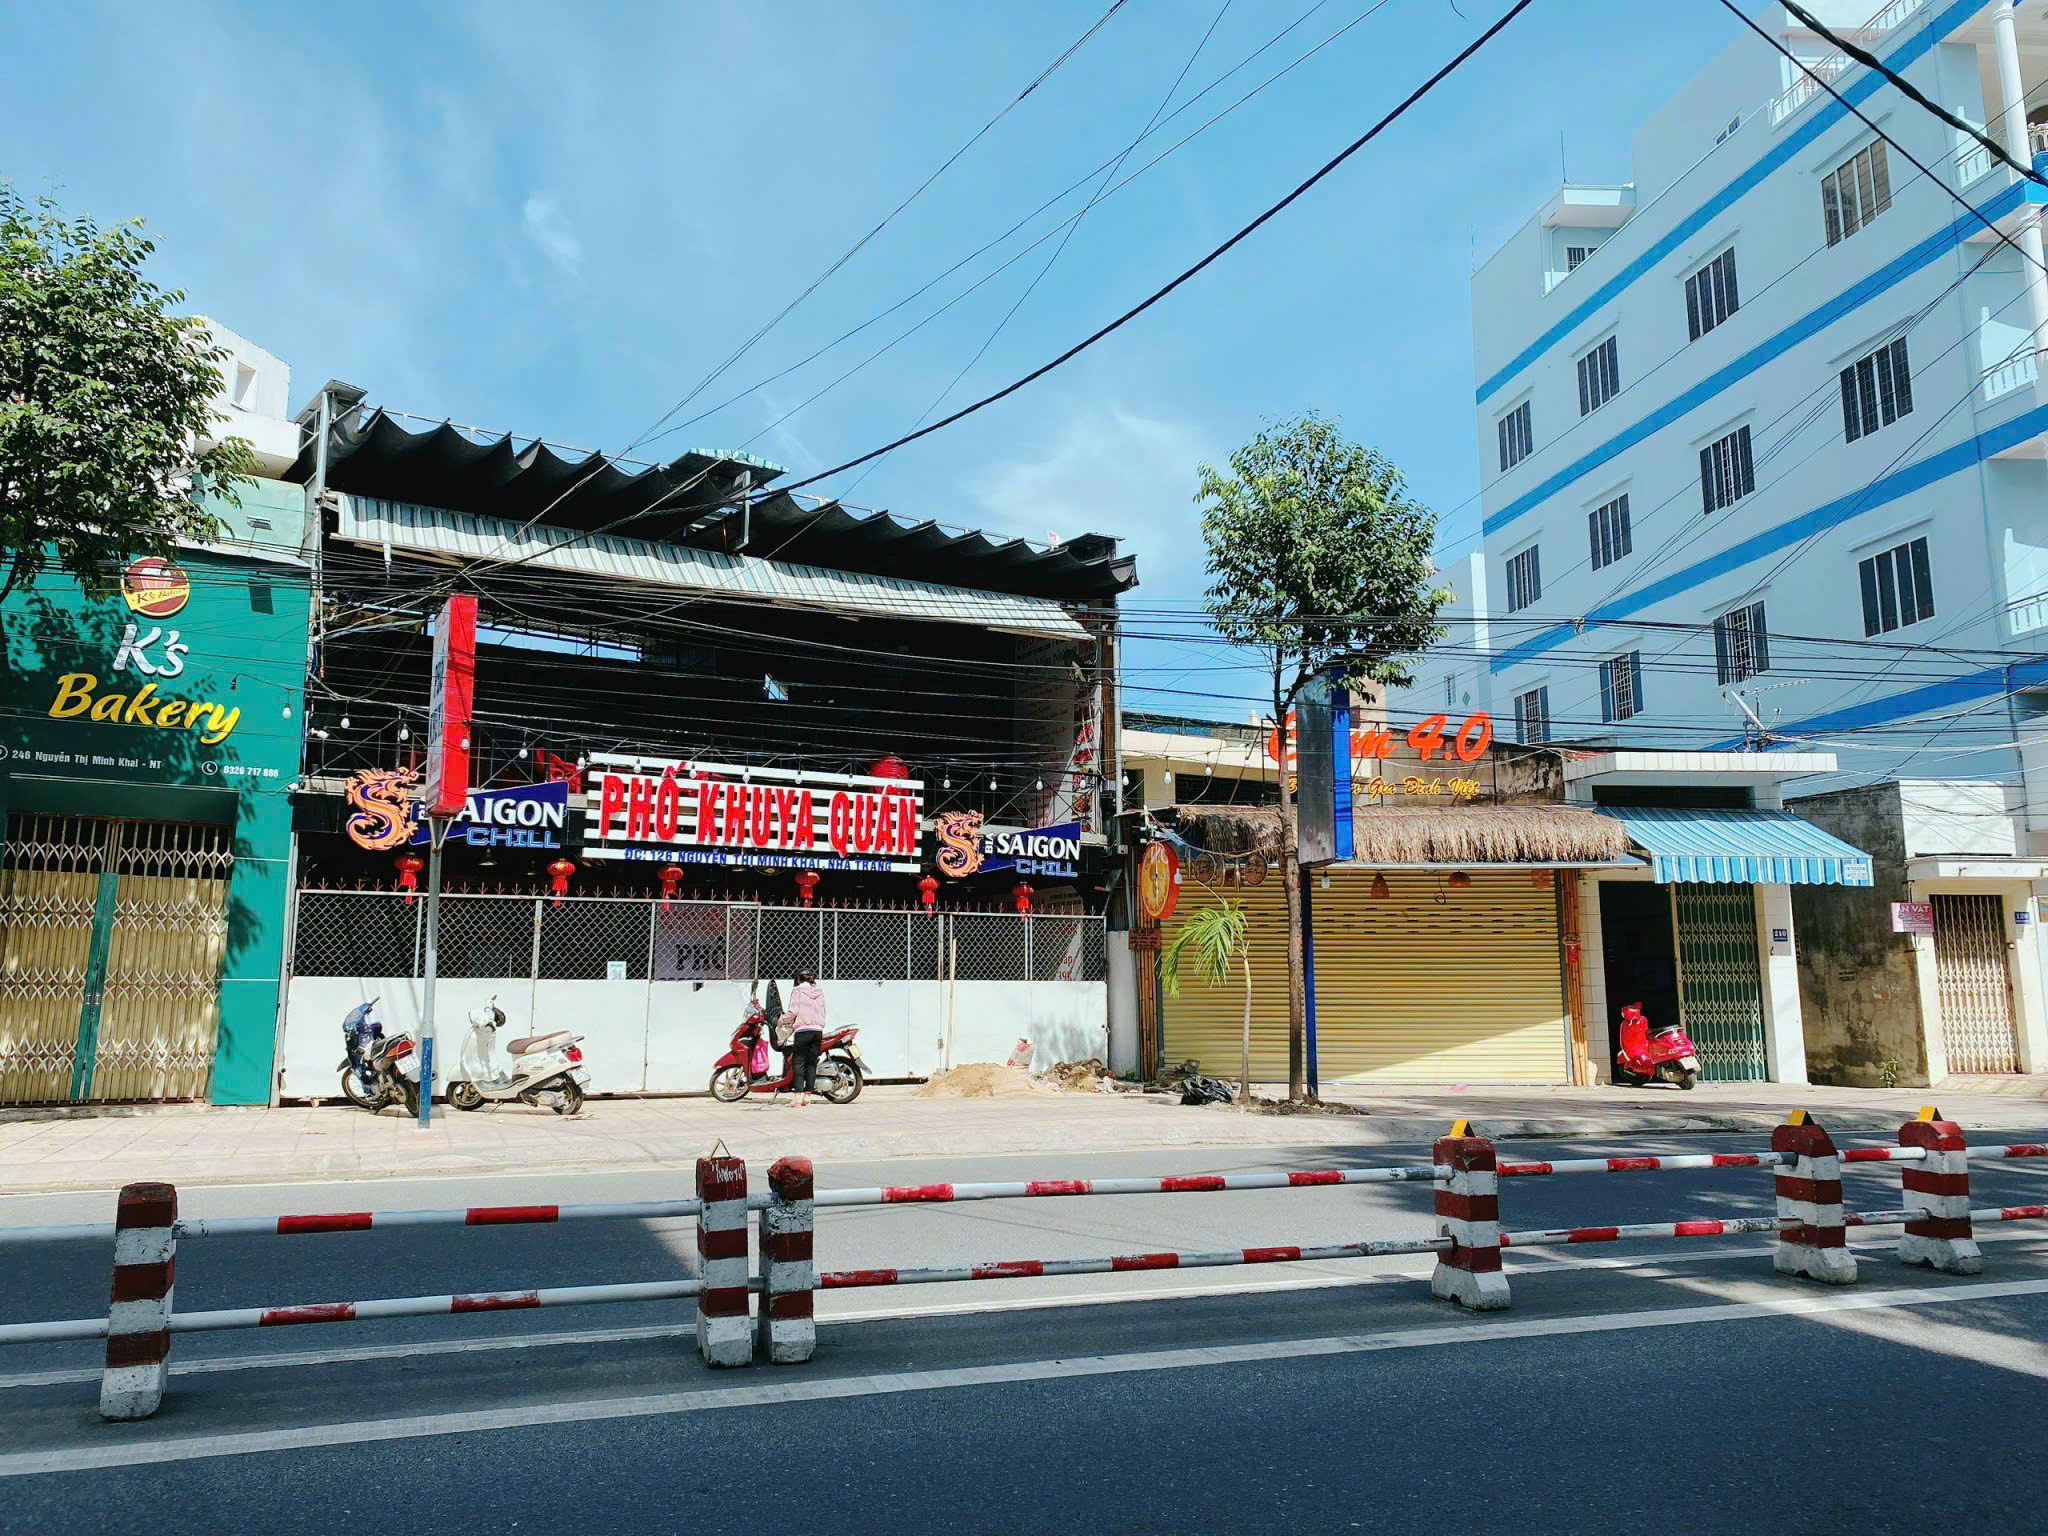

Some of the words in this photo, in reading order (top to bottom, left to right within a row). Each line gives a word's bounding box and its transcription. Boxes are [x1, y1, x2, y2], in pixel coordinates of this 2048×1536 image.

[113, 624, 189, 677] K's
[48, 673, 241, 744] Bakery
[1407, 711, 1492, 761] 4.0
[12, 750, 31, 760] 246
[149, 759, 162, 769] NT
[223, 765, 245, 775] 0326
[247, 767, 262, 777] 717
[1368, 776, 1397, 800] Gia
[456, 796, 566, 828] AIGON
[697, 782, 815, 849] KHUYA
[828, 785, 916, 858] QUÁN
[467, 827, 561, 849] CHILL
[997, 832, 1080, 860] SAIGON
[650, 849, 672, 861] 126
[757, 855, 788, 867] MINH
[828, 858, 850, 869] NHA
[855, 859, 892, 871] TRANG
[1016, 858, 1078, 877] CHILL
